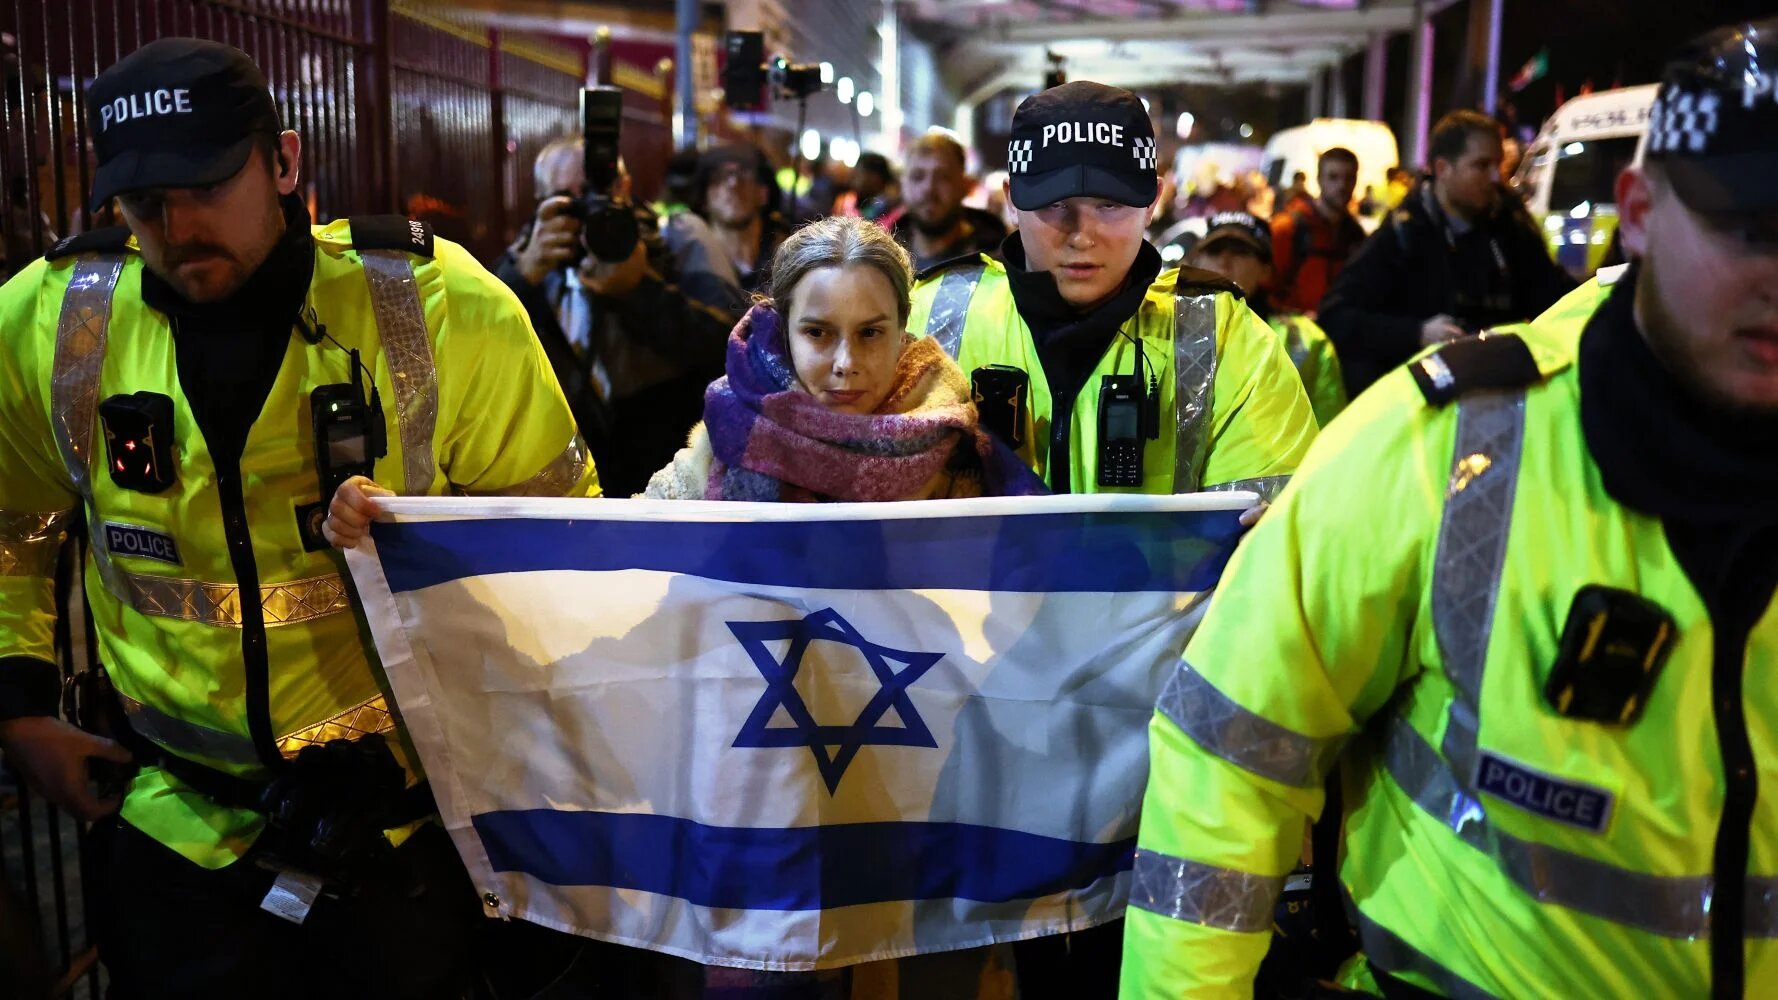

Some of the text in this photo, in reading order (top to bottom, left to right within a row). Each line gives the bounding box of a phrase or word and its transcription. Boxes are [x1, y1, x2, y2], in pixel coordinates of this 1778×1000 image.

[100, 88, 193, 133] POLICE
[1042, 121, 1124, 148] POLICE
[110, 530, 175, 558] POLICE
[1485, 761, 1598, 822] POLICE
